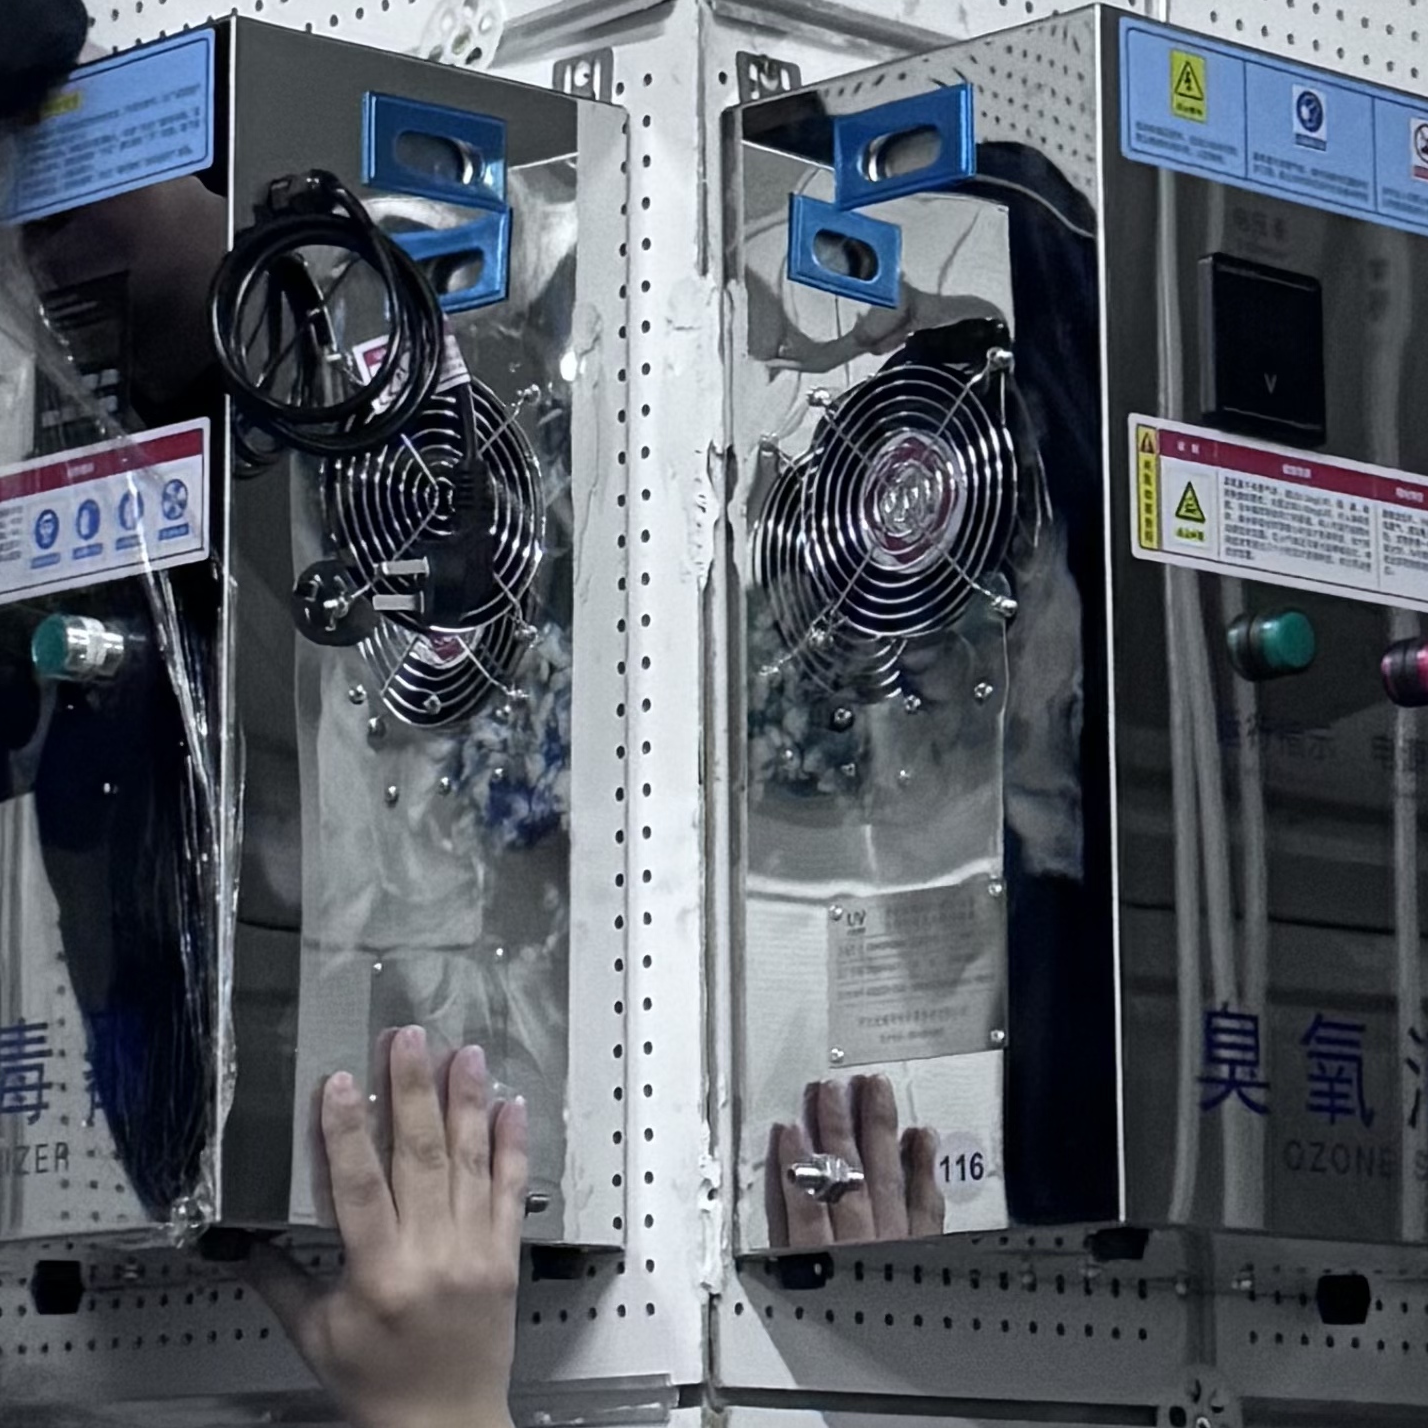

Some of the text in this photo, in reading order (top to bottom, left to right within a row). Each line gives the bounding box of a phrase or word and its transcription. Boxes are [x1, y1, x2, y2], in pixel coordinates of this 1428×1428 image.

[1264, 374, 1277, 395] V
[939, 1152, 984, 1183] 116
[1283, 1139, 1395, 1179] OZONE
